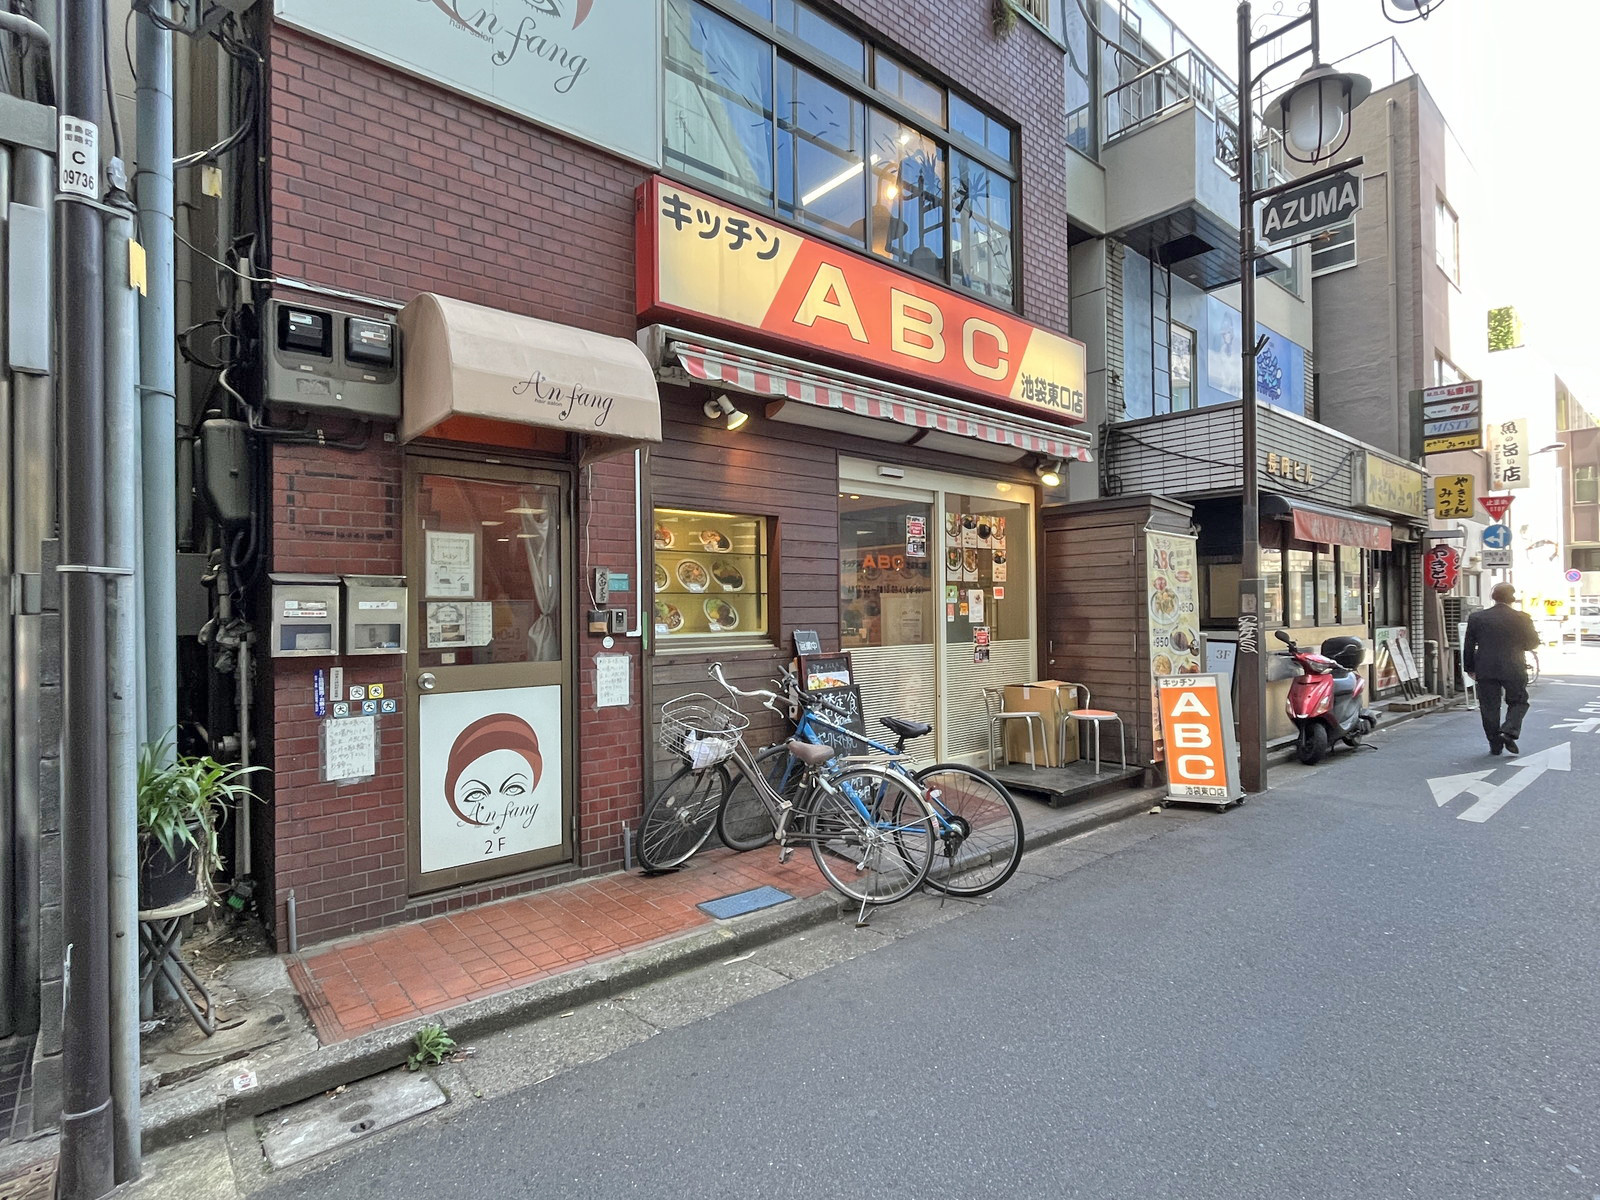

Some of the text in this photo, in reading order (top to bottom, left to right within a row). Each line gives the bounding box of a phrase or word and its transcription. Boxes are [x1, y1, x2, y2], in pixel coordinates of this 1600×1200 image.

[72, 151, 86, 165] C
[63, 169, 95, 190] 09736
[1264, 181, 1357, 235] AZUMA
[661, 193, 781, 261] キッチン
[792, 261, 1010, 382] ABC
[1020, 372, 1085, 415] 池袋東口店
[1429, 419, 1473, 434] MISTY
[1438, 488, 1453, 517] みつぼ
[1454, 476, 1469, 514] やきとん
[862, 554, 905, 569] ABC
[1153, 549, 1176, 571] ABC
[1430, 549, 1448, 589] やきとん
[1215, 649, 1231, 660] 3F
[1162, 678, 1196, 687] キッチン
[1170, 691, 1216, 780] ABC
[1185, 785, 1225, 797] 池袋東口店
